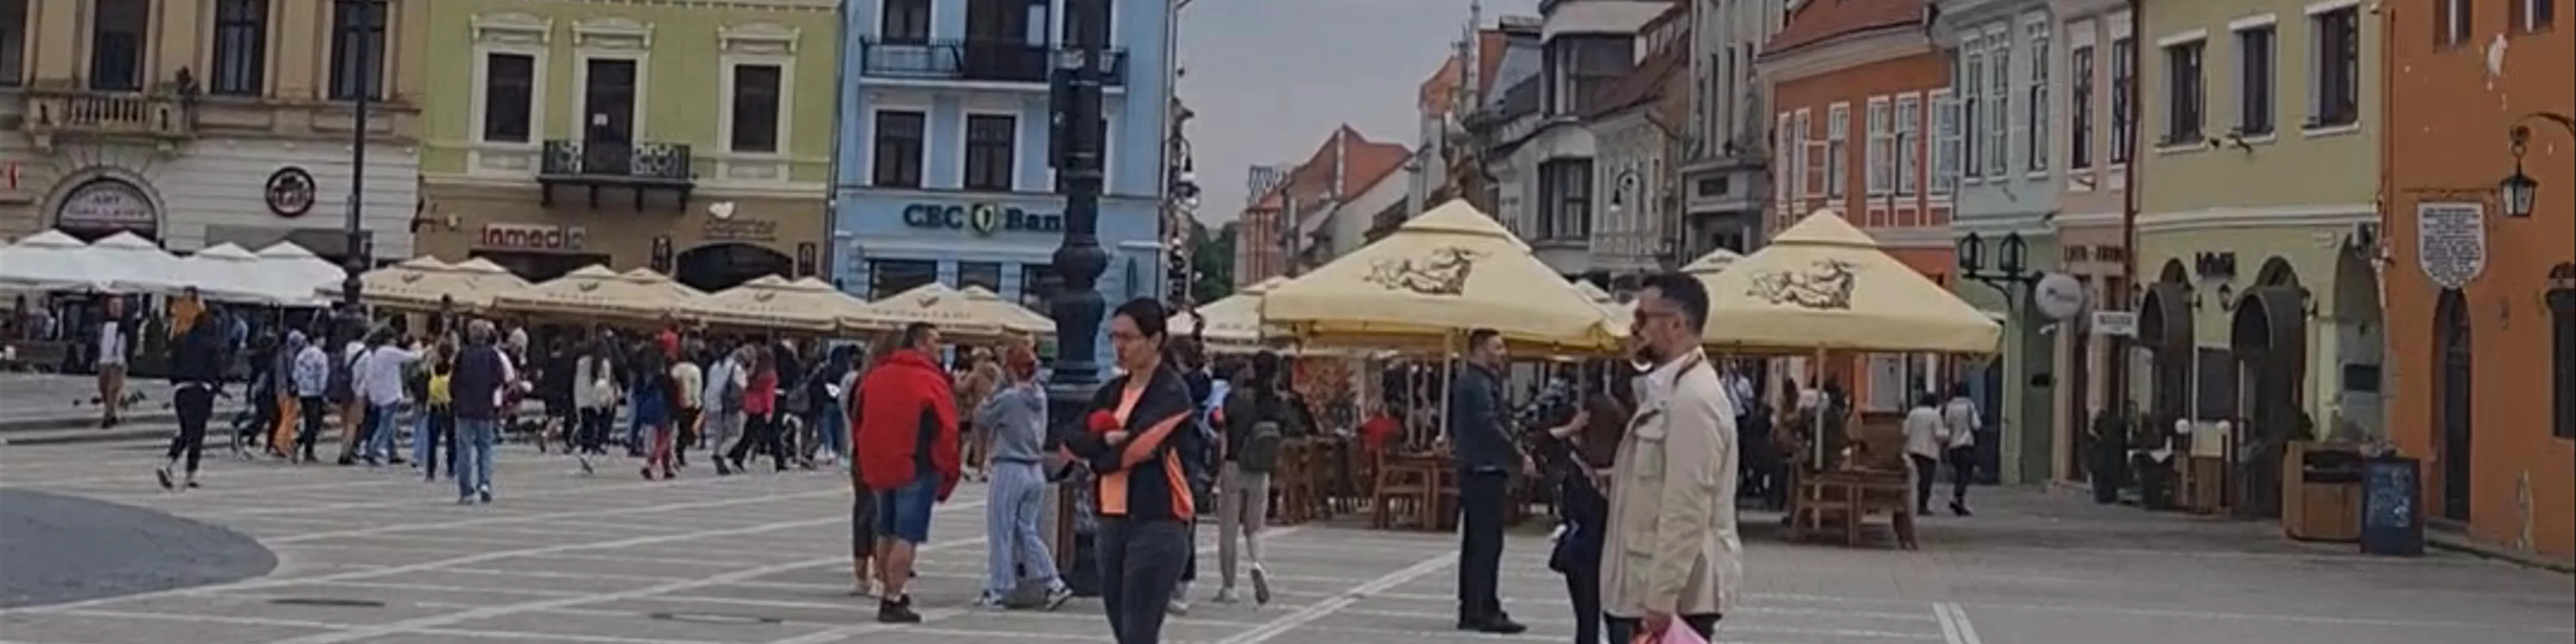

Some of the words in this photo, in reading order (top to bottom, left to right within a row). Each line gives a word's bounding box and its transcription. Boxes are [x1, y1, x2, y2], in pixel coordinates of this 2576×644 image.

[93, 195, 121, 205] ART
[903, 204, 964, 229] CEC
[1004, 207, 1065, 231] Ban
